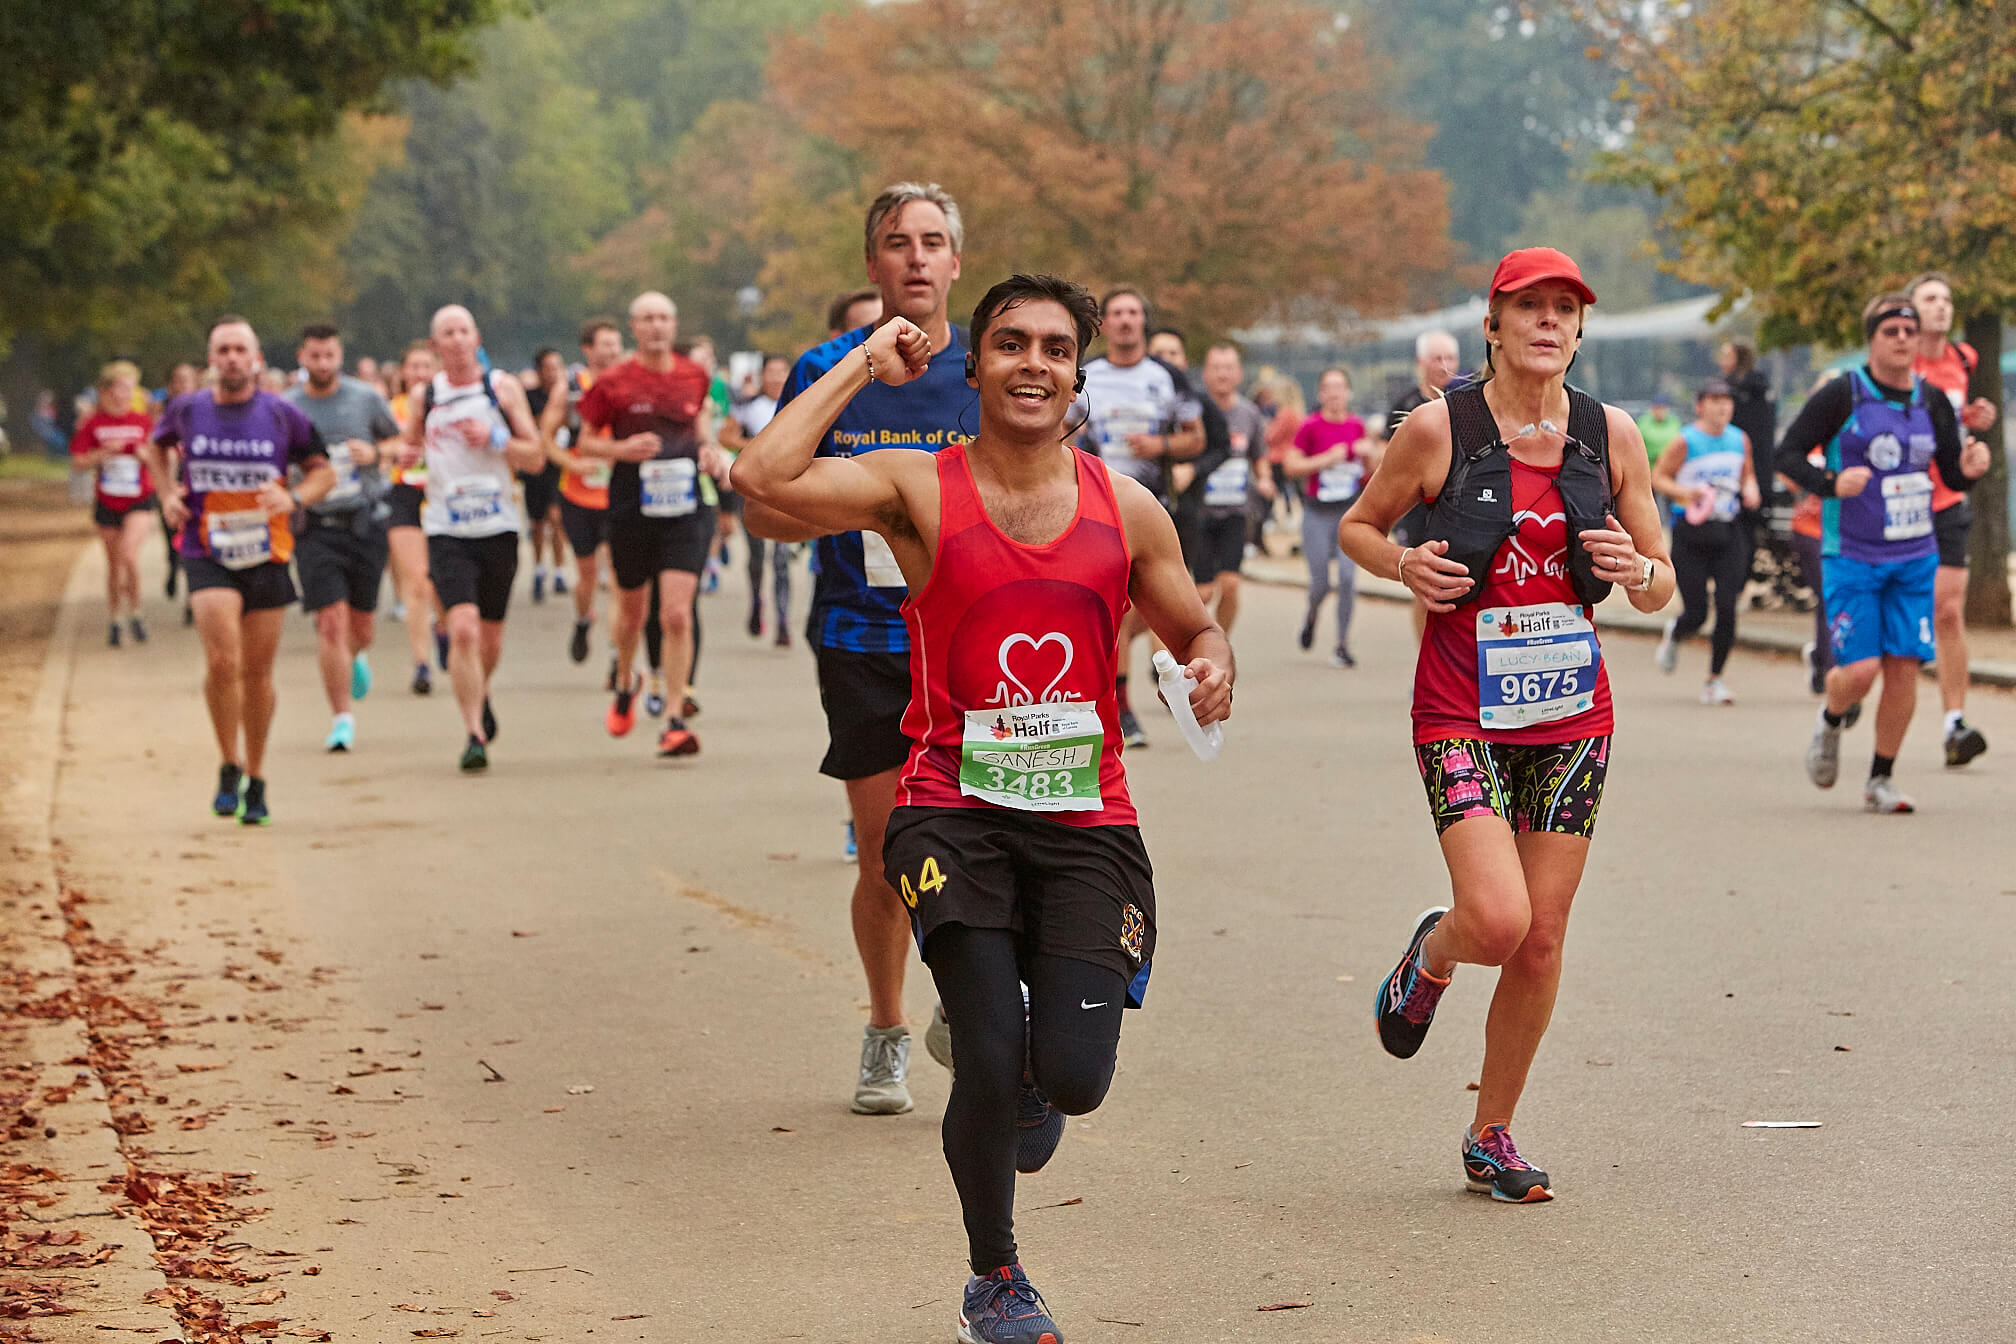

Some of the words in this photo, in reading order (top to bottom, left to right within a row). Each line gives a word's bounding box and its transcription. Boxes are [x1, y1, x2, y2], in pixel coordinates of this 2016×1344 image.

[208, 438, 275, 457] sense
[833, 430, 876, 448] Royal
[880, 430, 921, 445] Bank
[926, 430, 944, 445] of
[1519, 611, 1535, 620] Royal
[1520, 617, 1551, 633] Half
[1500, 654, 1538, 667] LUCY
[1543, 650, 1581, 664] BEAN
[1500, 669, 1579, 704] 9675
[1011, 713, 1030, 722] Royal
[1030, 712, 1050, 720] Parks
[1013, 720, 1050, 738] Half
[983, 767, 1074, 799] 3483
